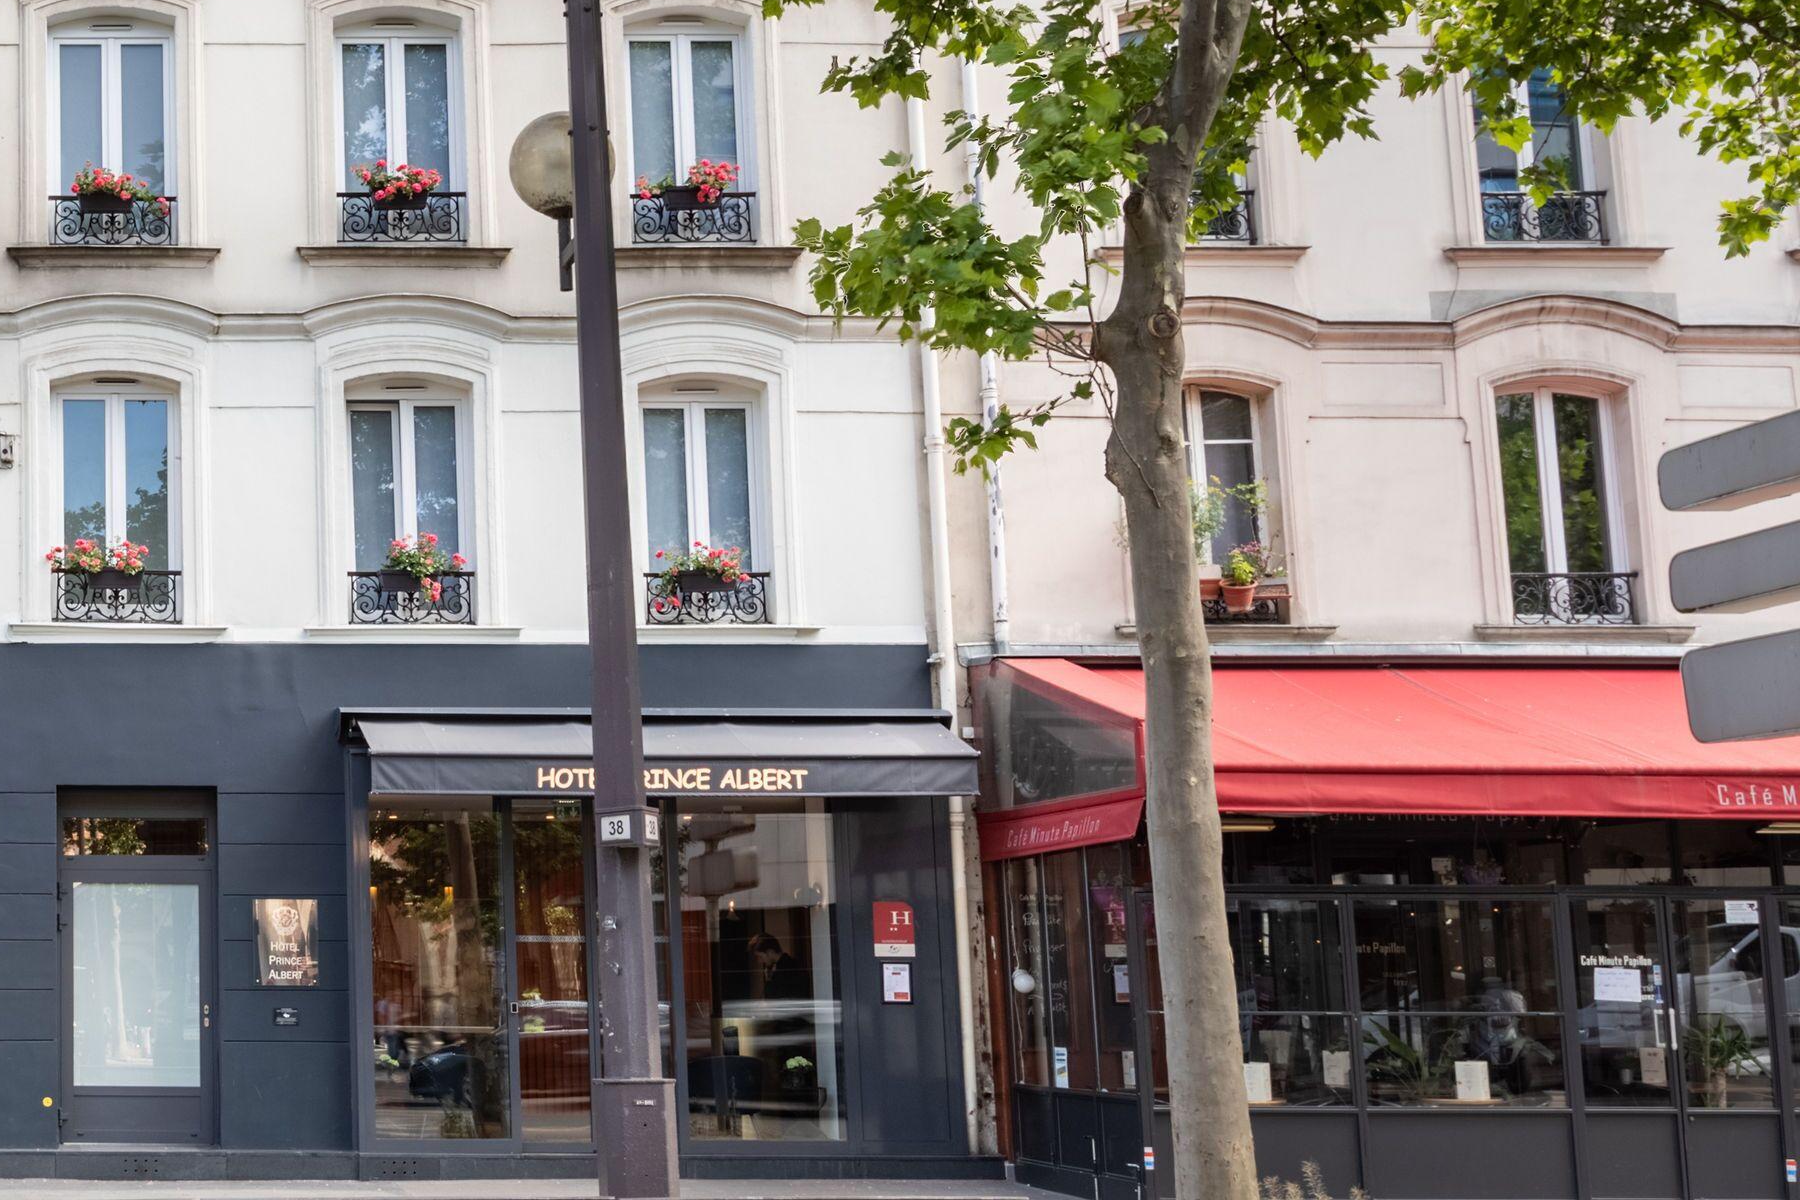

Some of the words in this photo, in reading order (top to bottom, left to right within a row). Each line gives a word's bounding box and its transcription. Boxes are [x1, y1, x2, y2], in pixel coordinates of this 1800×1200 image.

[537, 767, 596, 790] HOT
[643, 768, 711, 790] RINCE
[719, 768, 808, 790] ALBERT
[1717, 784, 1773, 806] Café
[608, 819, 625, 836] 38
[1007, 829, 1029, 848] Café
[1029, 825, 1060, 844] Minute
[1061, 816, 1100, 841] Papillon
[890, 911, 911, 925] H
[269, 955, 303, 965] PRINCE
[1580, 954, 1597, 966] Café
[1598, 954, 1623, 966] Minute
[1623, 955, 1652, 968] Papillon
[269, 969, 304, 979] ALBERT
